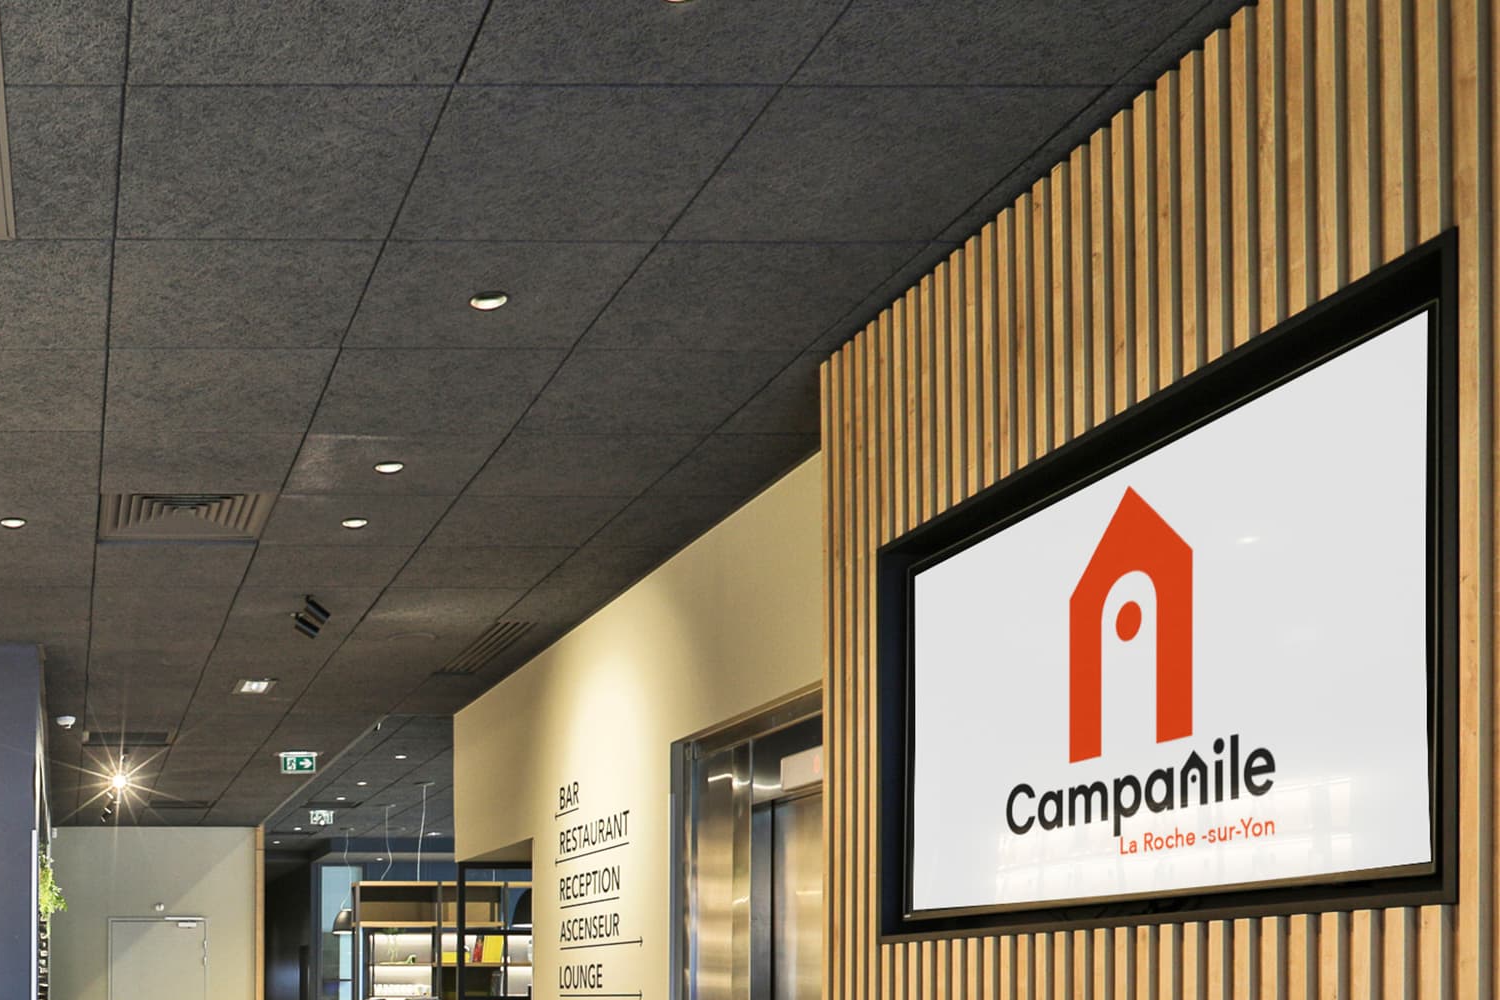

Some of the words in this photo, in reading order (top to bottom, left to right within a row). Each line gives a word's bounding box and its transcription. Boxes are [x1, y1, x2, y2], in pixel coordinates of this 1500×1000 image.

[559, 781, 580, 811] BAR
[1006, 733, 1276, 838] Campanile
[559, 810, 630, 854] RESTAURANT
[1119, 836, 1137, 855] La
[1143, 827, 1196, 852] Roche
[559, 866, 621, 901] RECEPTION
[559, 912, 620, 942] ASCENSEUR
[559, 963, 603, 990] LOUNGE
